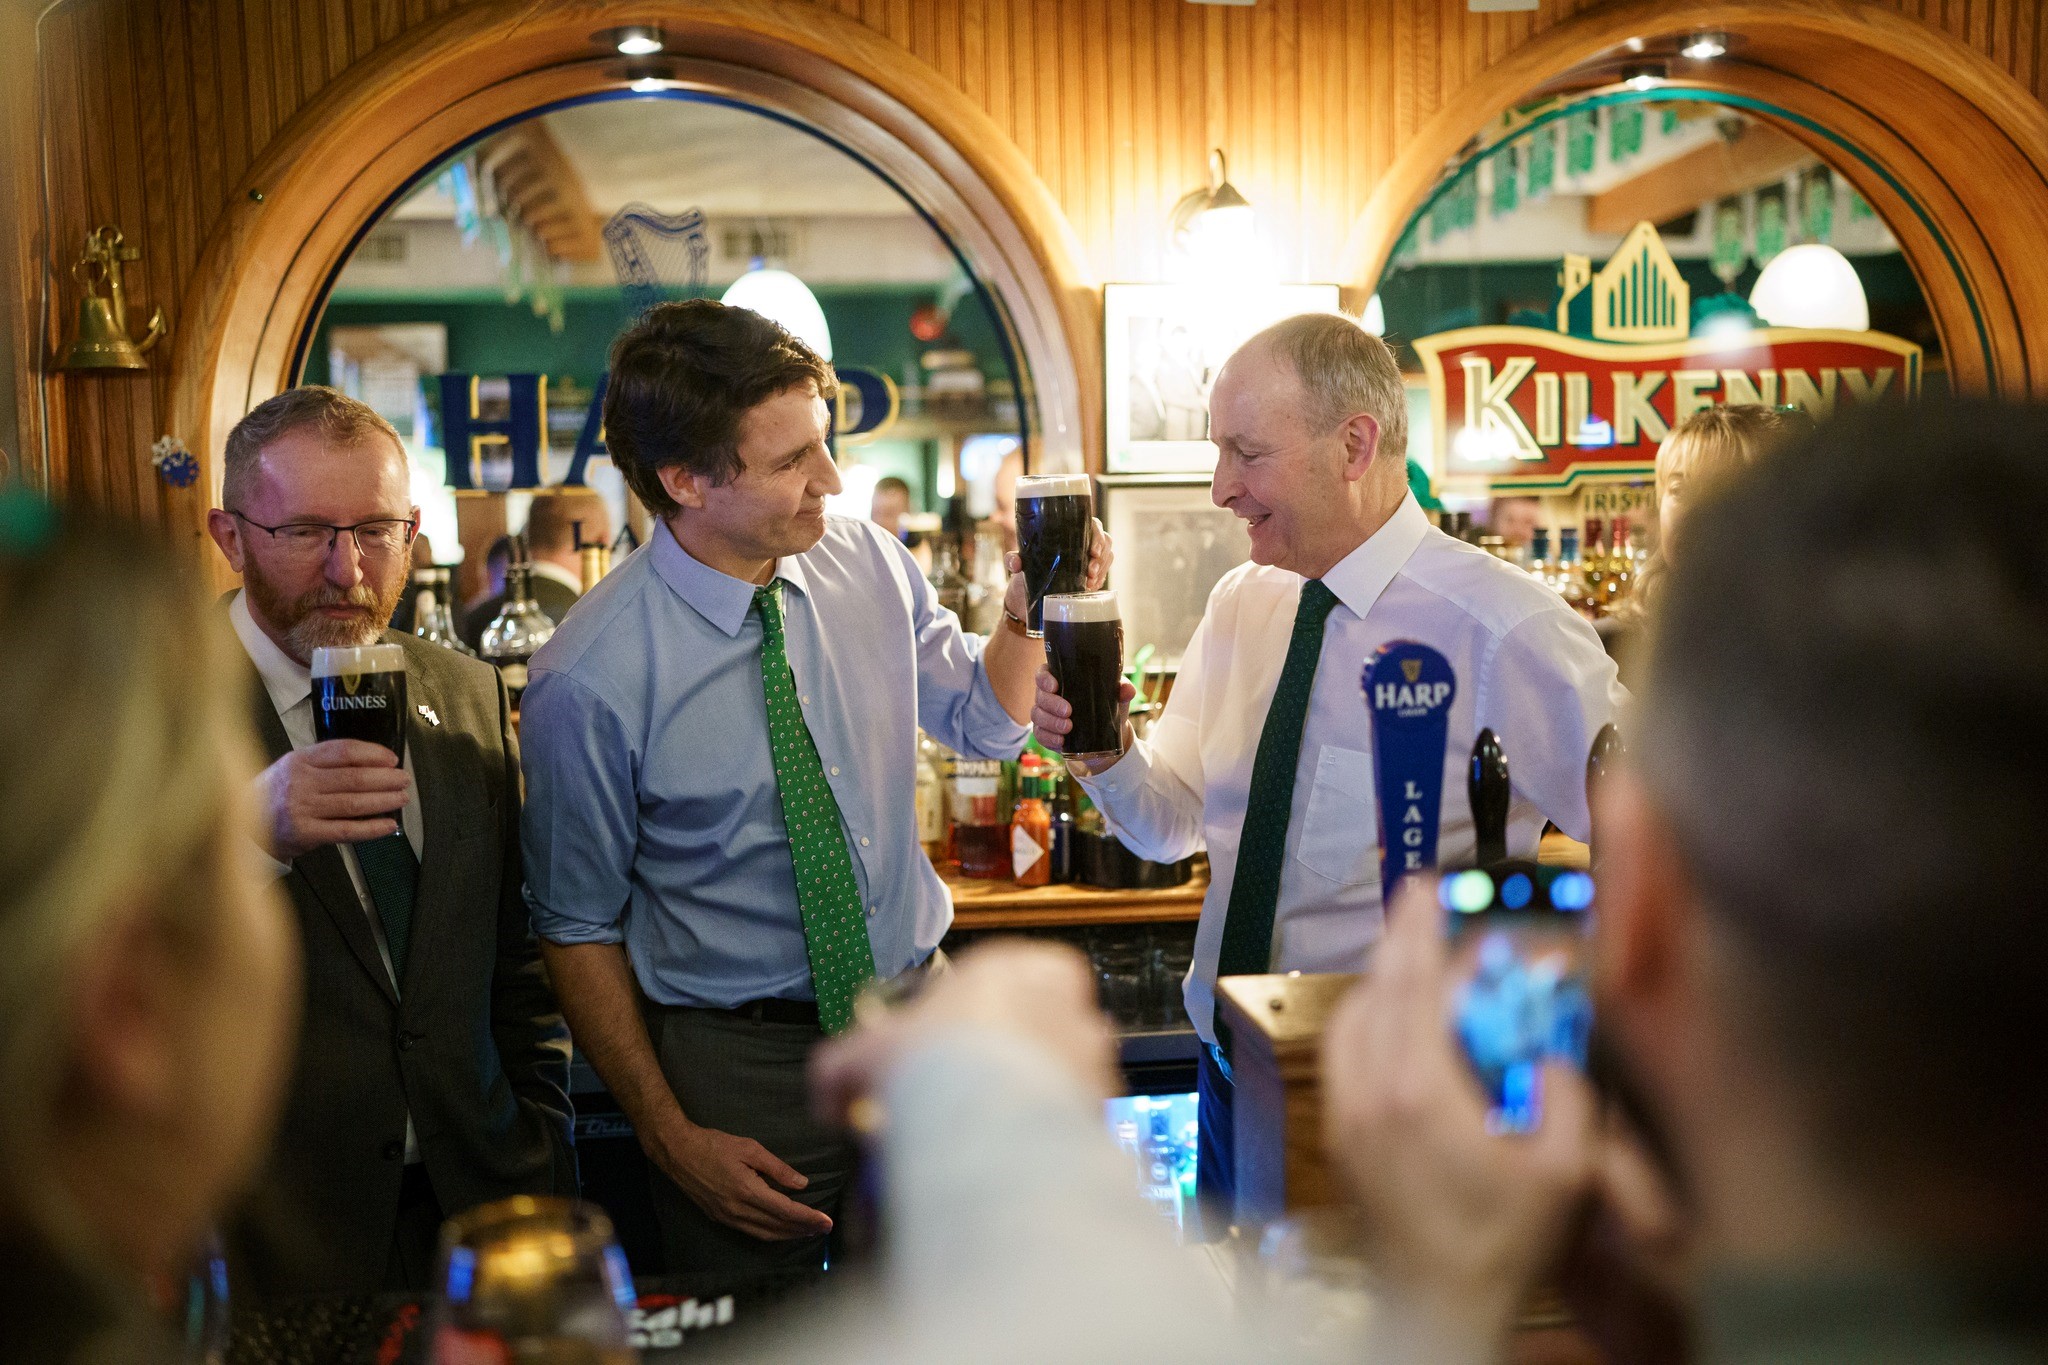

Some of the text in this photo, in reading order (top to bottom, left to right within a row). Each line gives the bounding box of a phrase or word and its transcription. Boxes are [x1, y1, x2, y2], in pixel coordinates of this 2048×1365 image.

[321, 695, 388, 711] GUINNESS
[1374, 682, 1450, 710] HARP
[1402, 780, 1424, 888] LAGE
